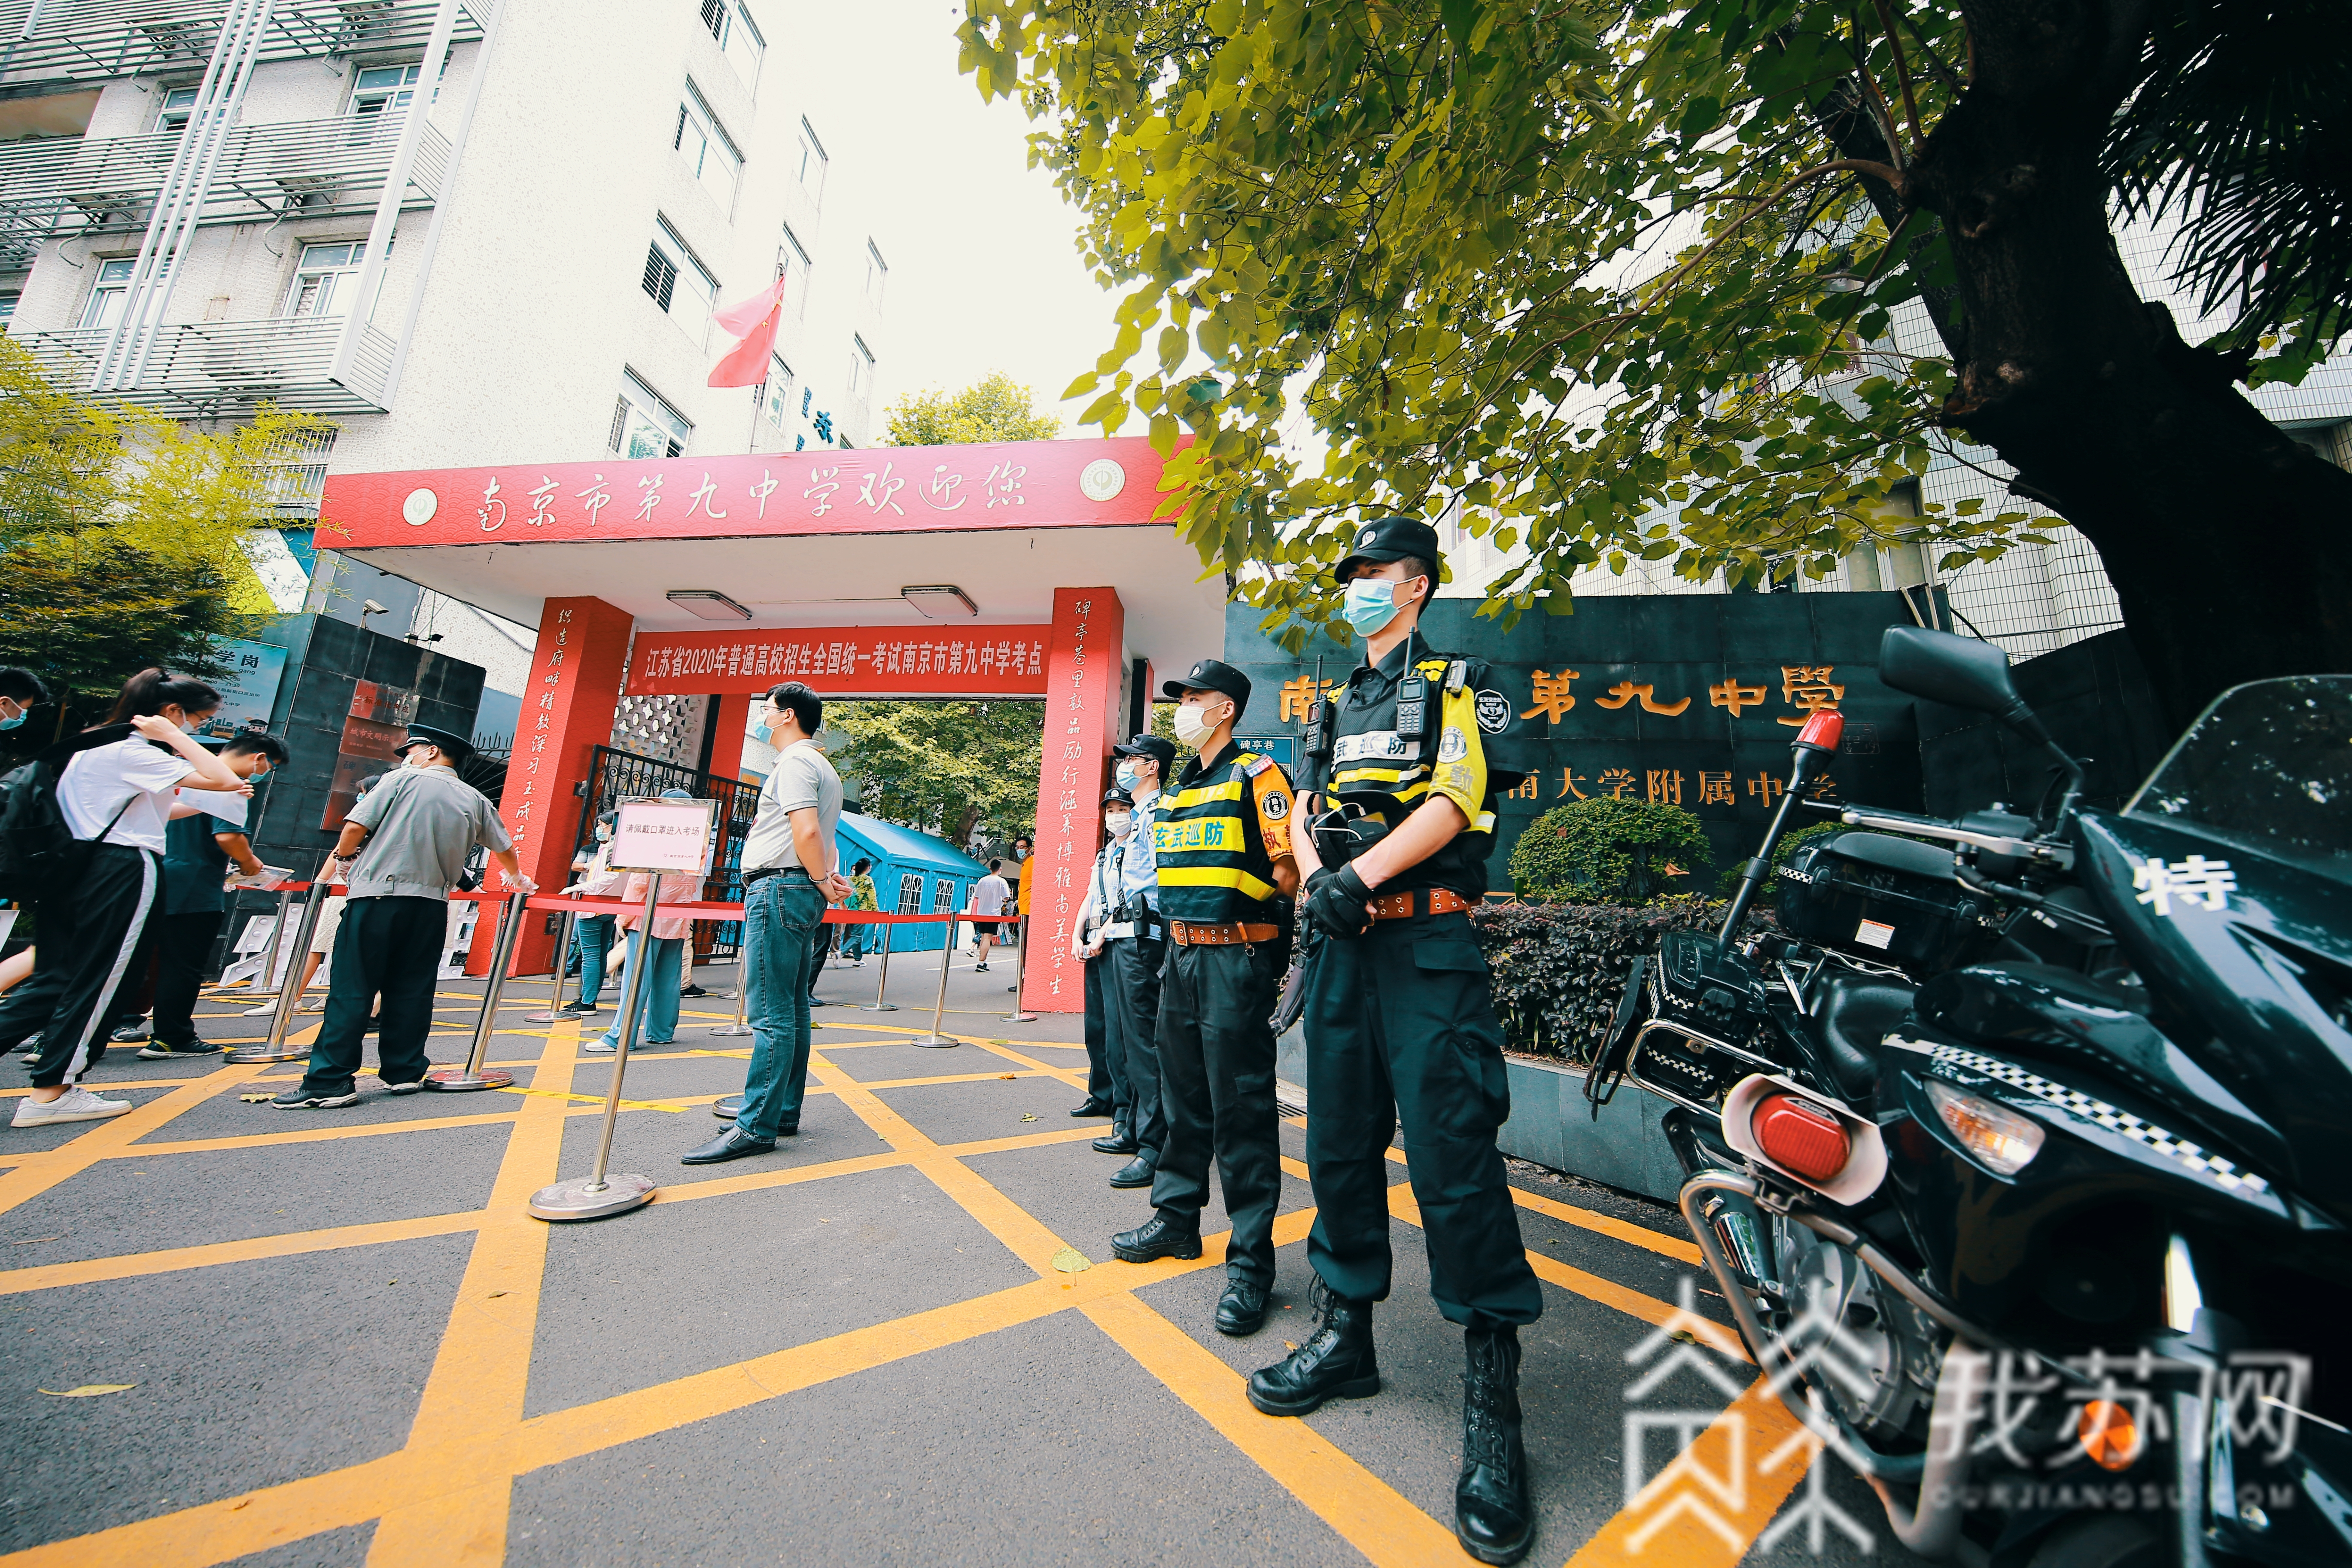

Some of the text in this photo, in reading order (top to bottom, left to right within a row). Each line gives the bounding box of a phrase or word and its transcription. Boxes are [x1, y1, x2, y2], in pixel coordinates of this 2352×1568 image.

[477, 460, 1027, 532] 南京市第九中学欢迎您
[214, 650, 259, 668] 学岗
[645, 642, 1042, 678] 江苏省2020年普通高校招生全国统一考试南京市第九中学考点
[213, 687, 260, 697] 分局新街口派出所
[1279, 665, 1844, 726] 南第九中學
[364, 696, 410, 713] 标准化考点
[350, 728, 403, 744] 城市文明示
[1240, 740, 1275, 750] 碑亭巷
[1336, 736, 1407, 759] 武巡防
[1444, 735, 1455, 753] 勤务
[500, 609, 573, 891] 织造府畔精教深习玉成品
[1049, 600, 1091, 994] 碑亭巷里敦品励行涵养博雅尚美学生
[1508, 767, 1837, 807] 南大学附属中学
[626, 824, 700, 836] 请佩戴口罩进入考场
[1155, 821, 1225, 848] 玄武巡防
[1263, 825, 1291, 849] 执
[2133, 855, 2237, 916] 特
